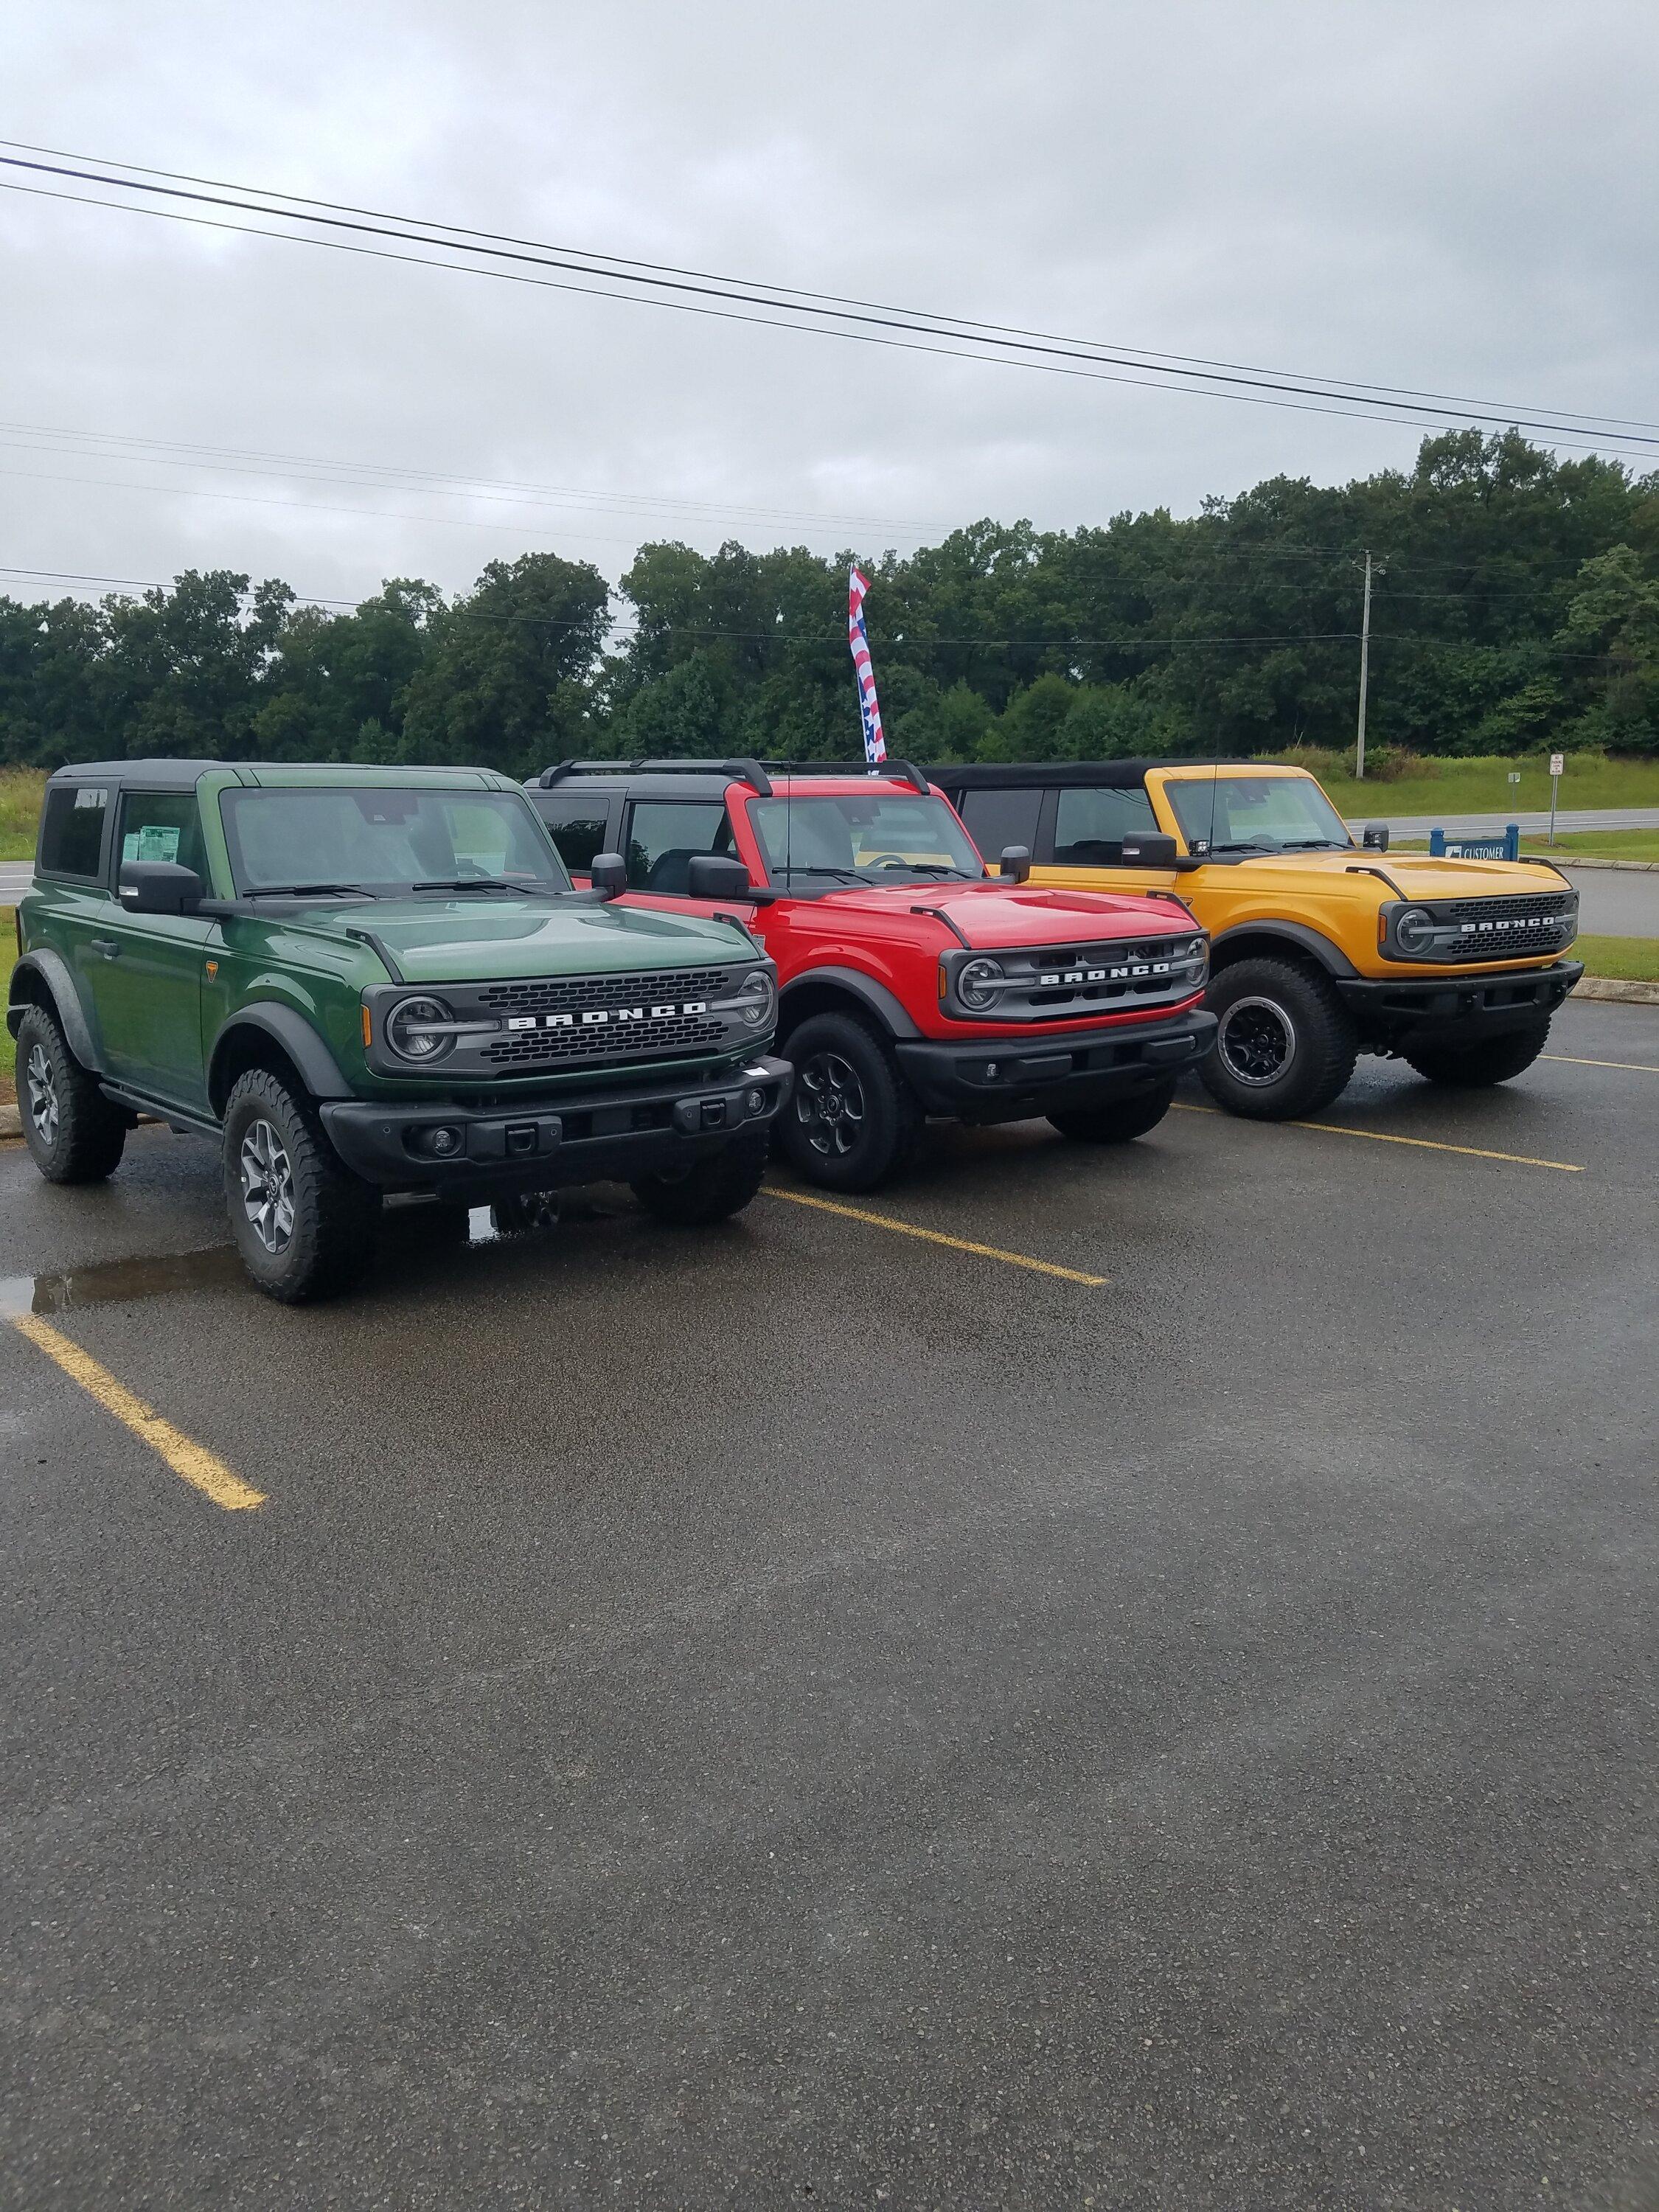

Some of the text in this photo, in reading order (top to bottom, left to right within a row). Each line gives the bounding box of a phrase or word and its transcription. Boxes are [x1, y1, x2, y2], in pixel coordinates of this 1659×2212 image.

[1464, 846, 1503, 860] CUSTOMER
[1461, 917, 1554, 932] BRONCO
[1040, 963, 1169, 985] BRONCO
[508, 1002, 706, 1030] BRONCO
